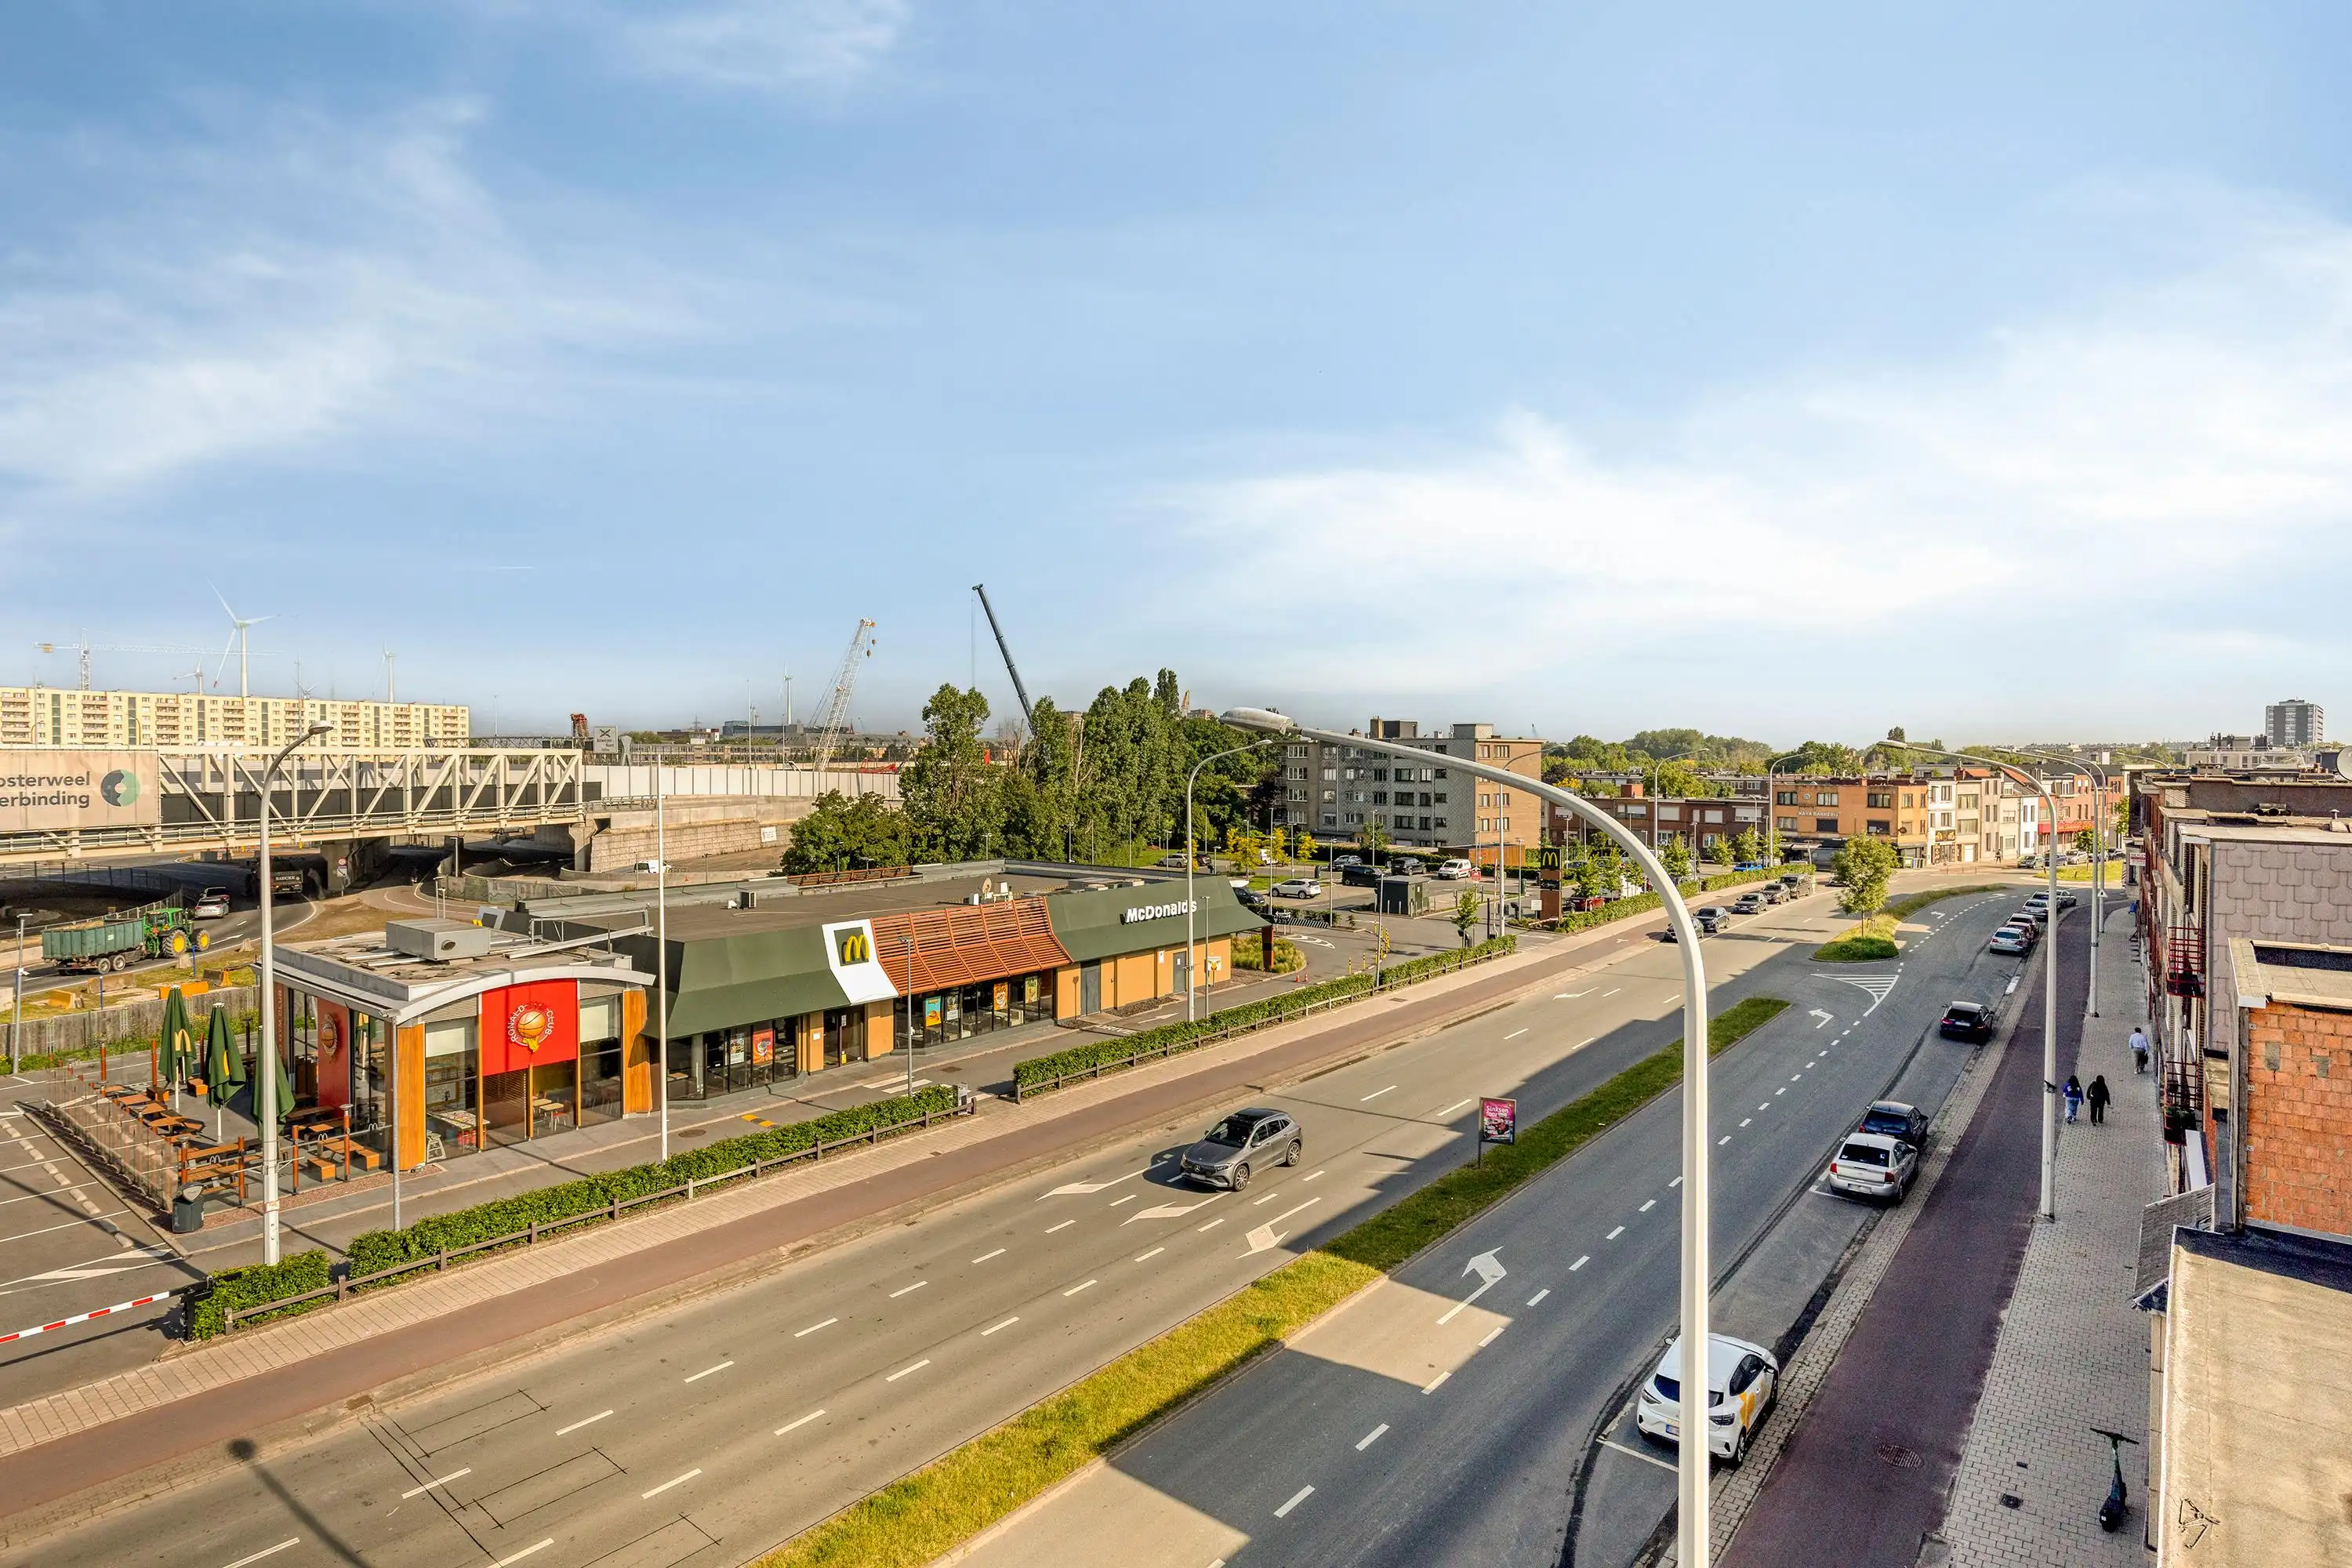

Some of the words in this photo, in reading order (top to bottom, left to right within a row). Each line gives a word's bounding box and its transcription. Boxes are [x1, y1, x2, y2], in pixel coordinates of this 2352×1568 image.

[0, 790, 90, 808] erbinding
[507, 1004, 525, 1043] RONALD
[544, 1010, 555, 1036] CLUB
[1486, 1105, 1509, 1114] Sinksen
